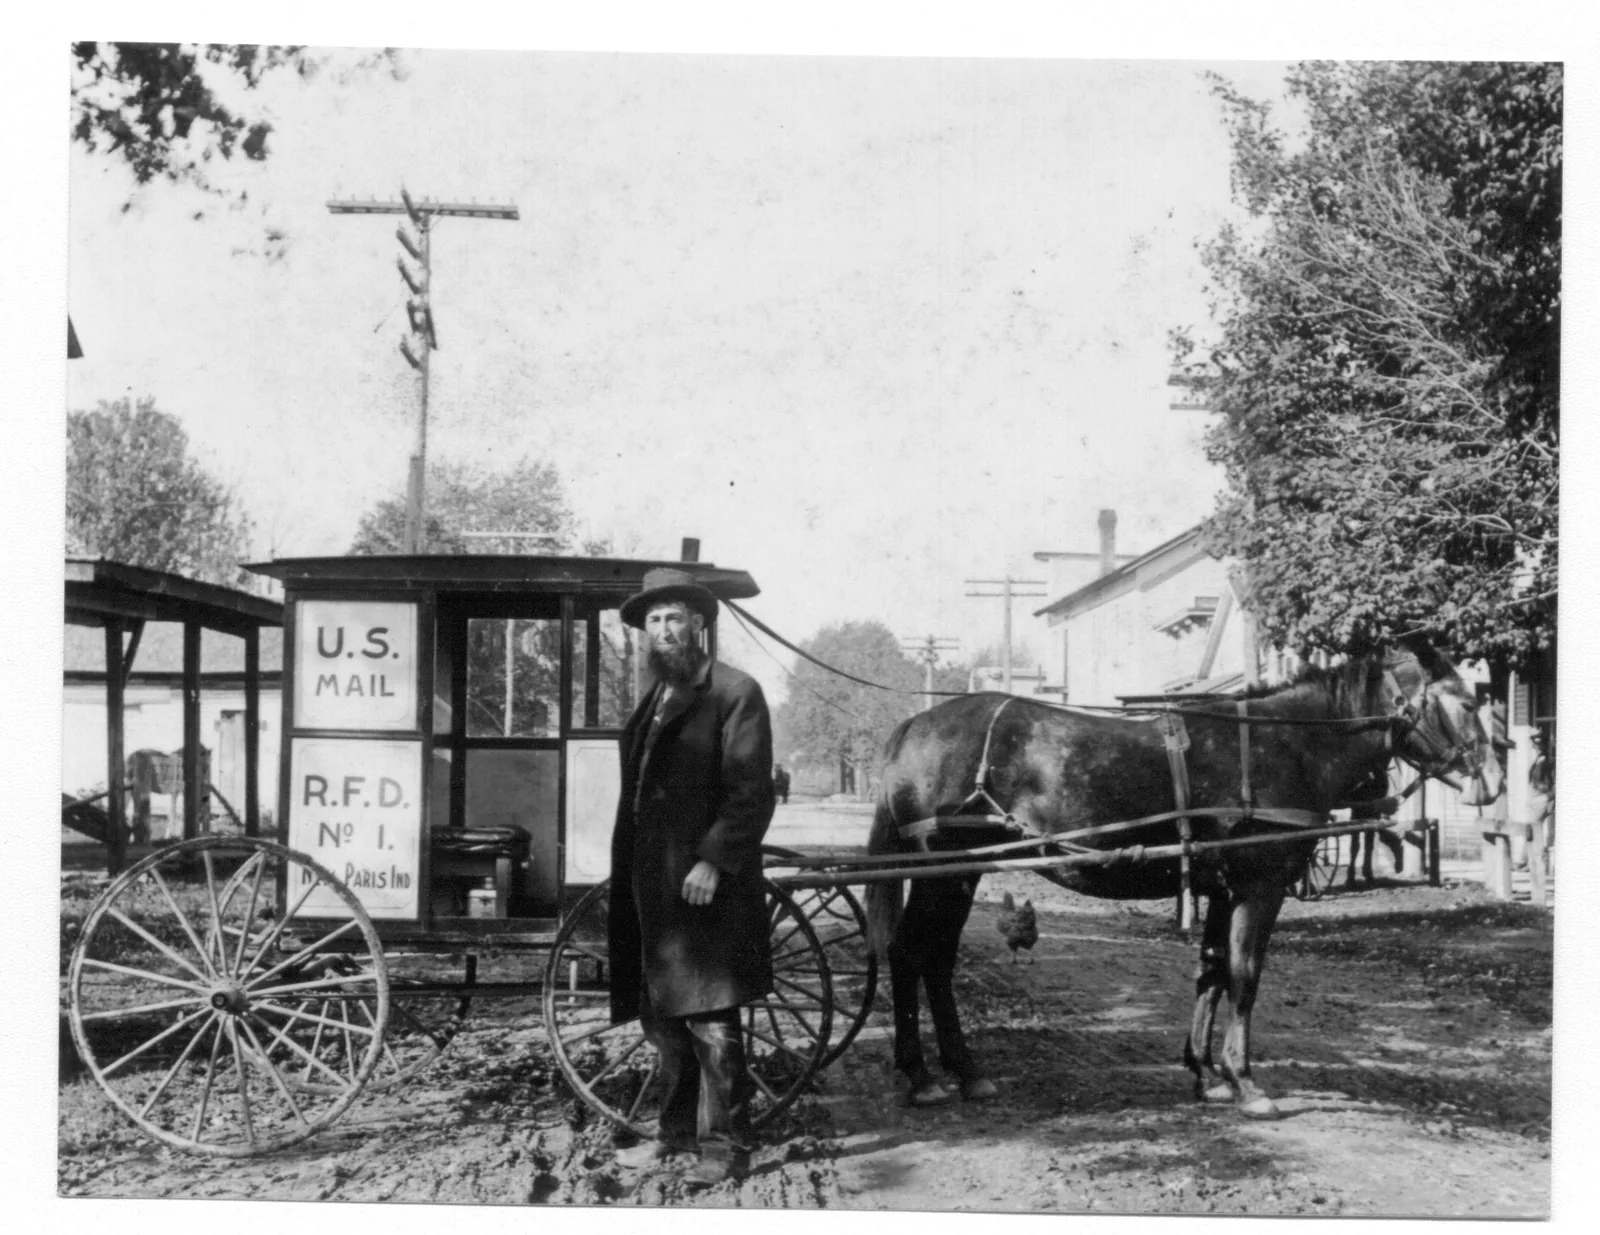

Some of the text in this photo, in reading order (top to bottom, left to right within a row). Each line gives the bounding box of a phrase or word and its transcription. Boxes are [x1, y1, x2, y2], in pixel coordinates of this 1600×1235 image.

[317, 627, 400, 659] U.S.
[316, 675, 395, 697] MAIL
[304, 775, 410, 807] R.F.D.
